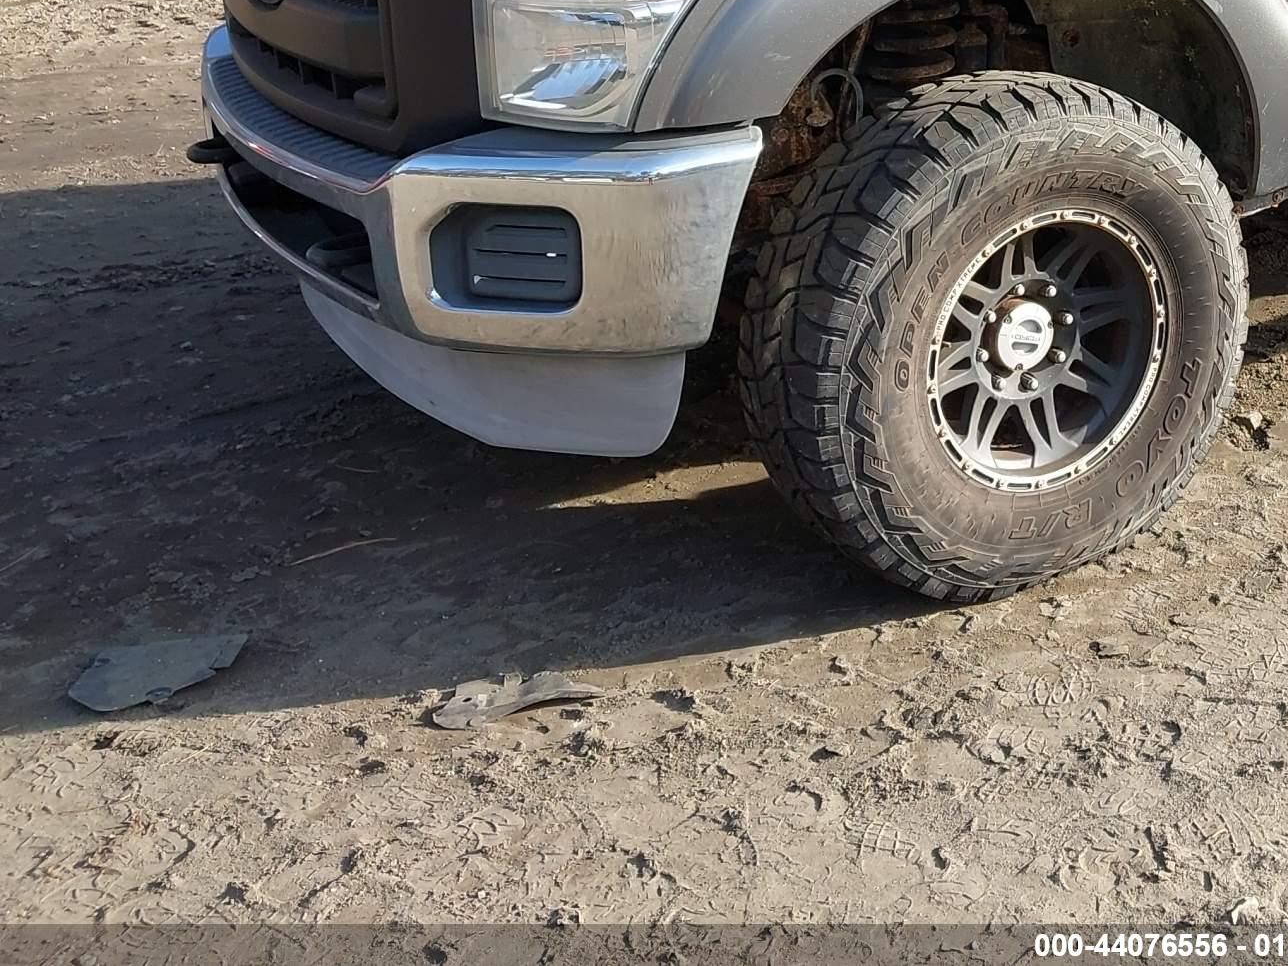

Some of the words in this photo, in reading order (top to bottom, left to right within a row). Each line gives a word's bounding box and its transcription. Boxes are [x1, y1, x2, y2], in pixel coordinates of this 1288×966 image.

[895, 250, 950, 392] OPEN
[960, 170, 1149, 246] COUNTRY
[1115, 357, 1202, 498] TOYO
[1008, 497, 1093, 540] R/T
